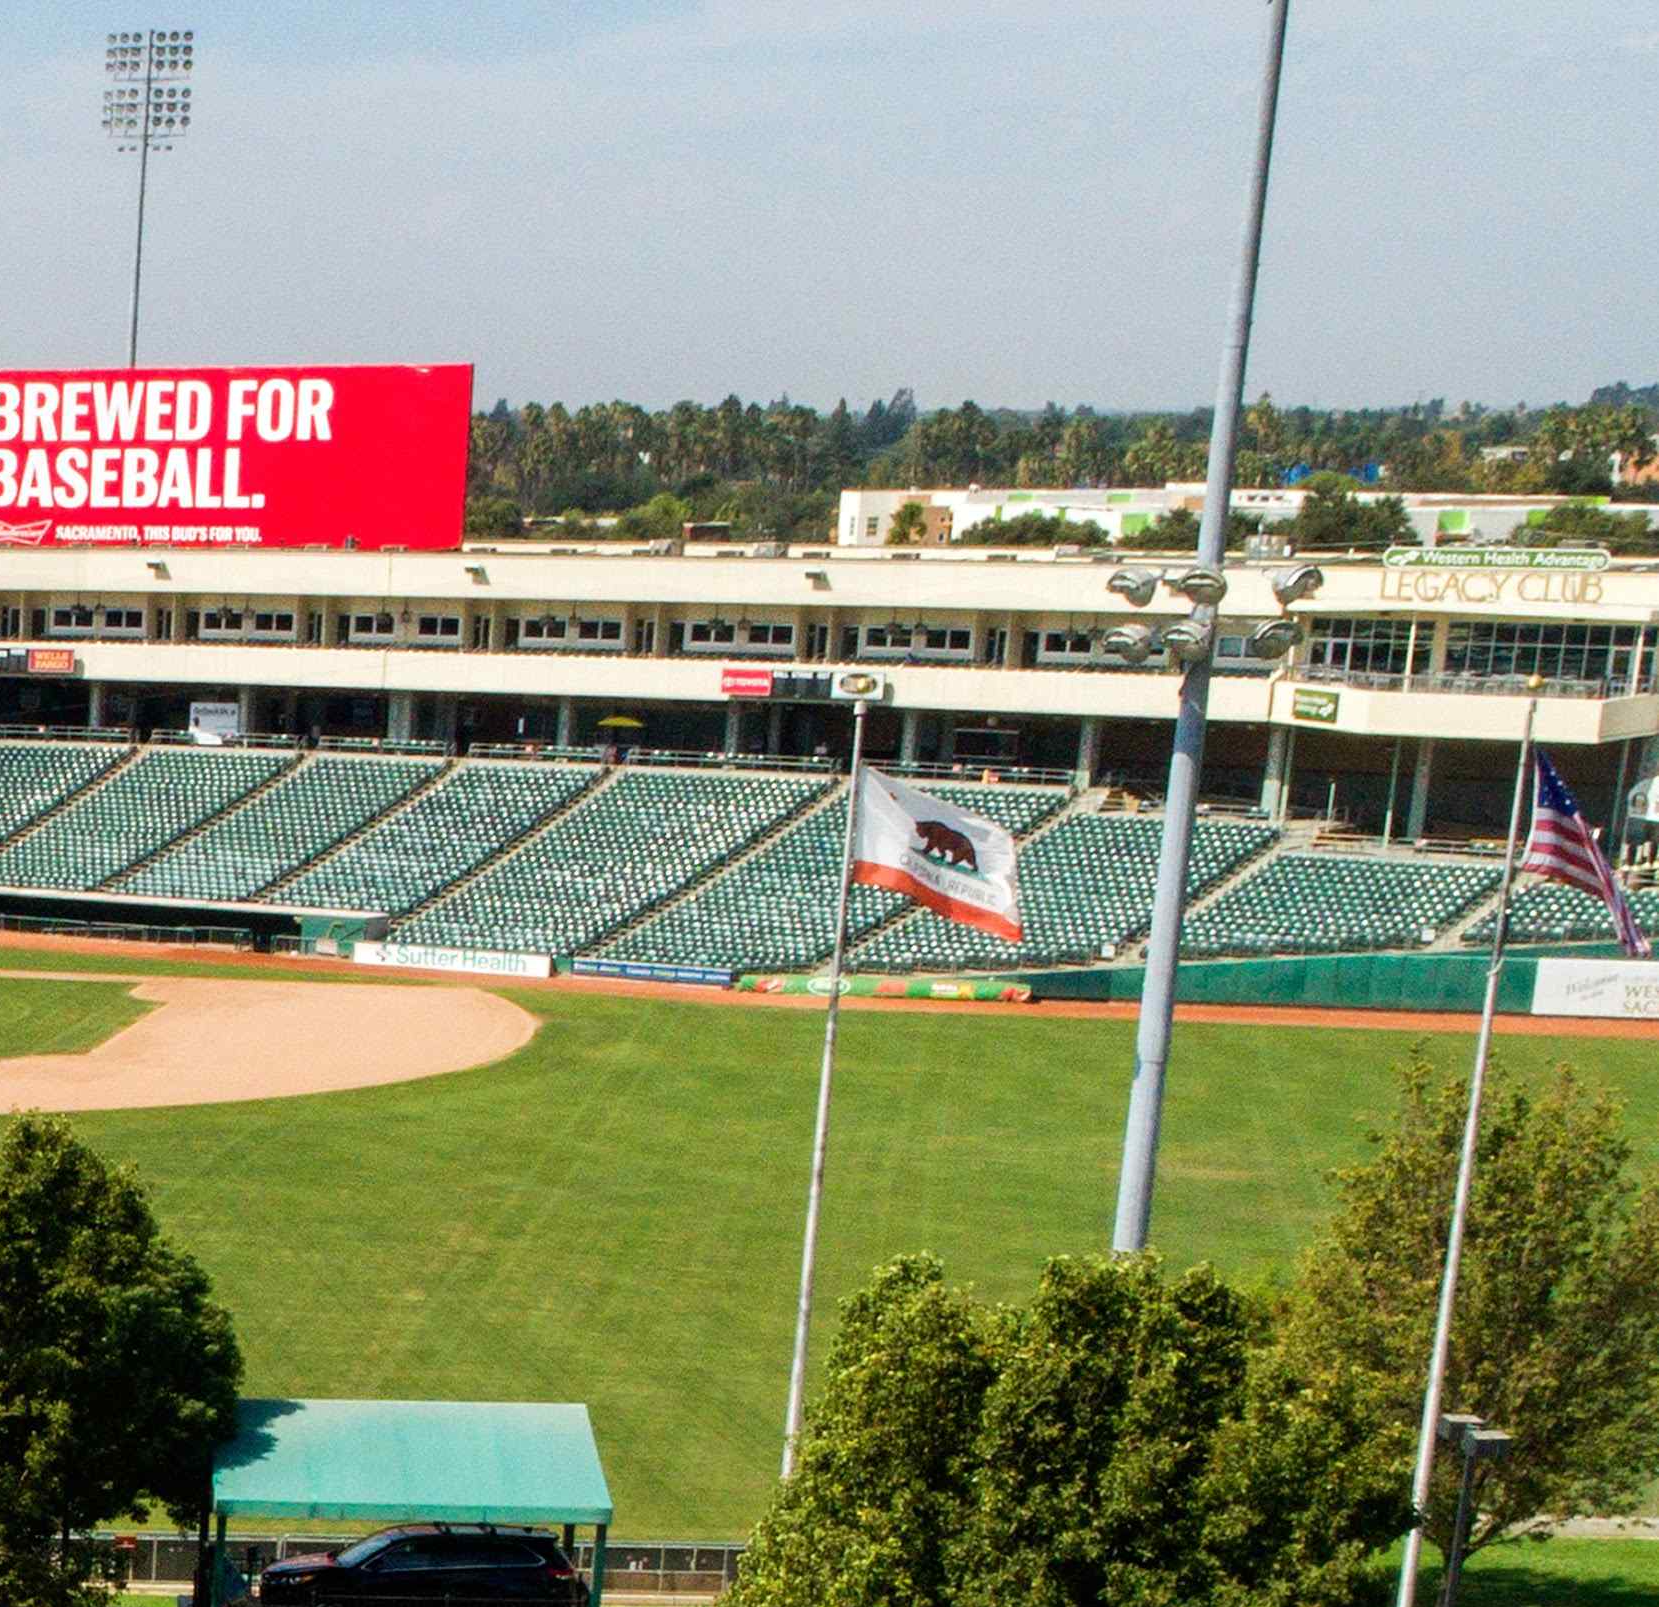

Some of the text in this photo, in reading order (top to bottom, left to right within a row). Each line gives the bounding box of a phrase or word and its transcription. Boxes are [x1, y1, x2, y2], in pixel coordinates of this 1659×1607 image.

[226, 378, 334, 441] FOR
[55, 524, 141, 542] SACRAMENTO,
[143, 525, 169, 541] THIS
[209, 526, 233, 541] FOR
[234, 526, 262, 542] YOU.
[1421, 551, 1481, 566] Western
[1484, 552, 1530, 567] Health
[1380, 571, 1604, 604] LEGACY CLUB
[35, 651, 69, 660] WELLS
[35, 660, 69, 668] FARGO
[396, 947, 528, 973] Sutter Health
